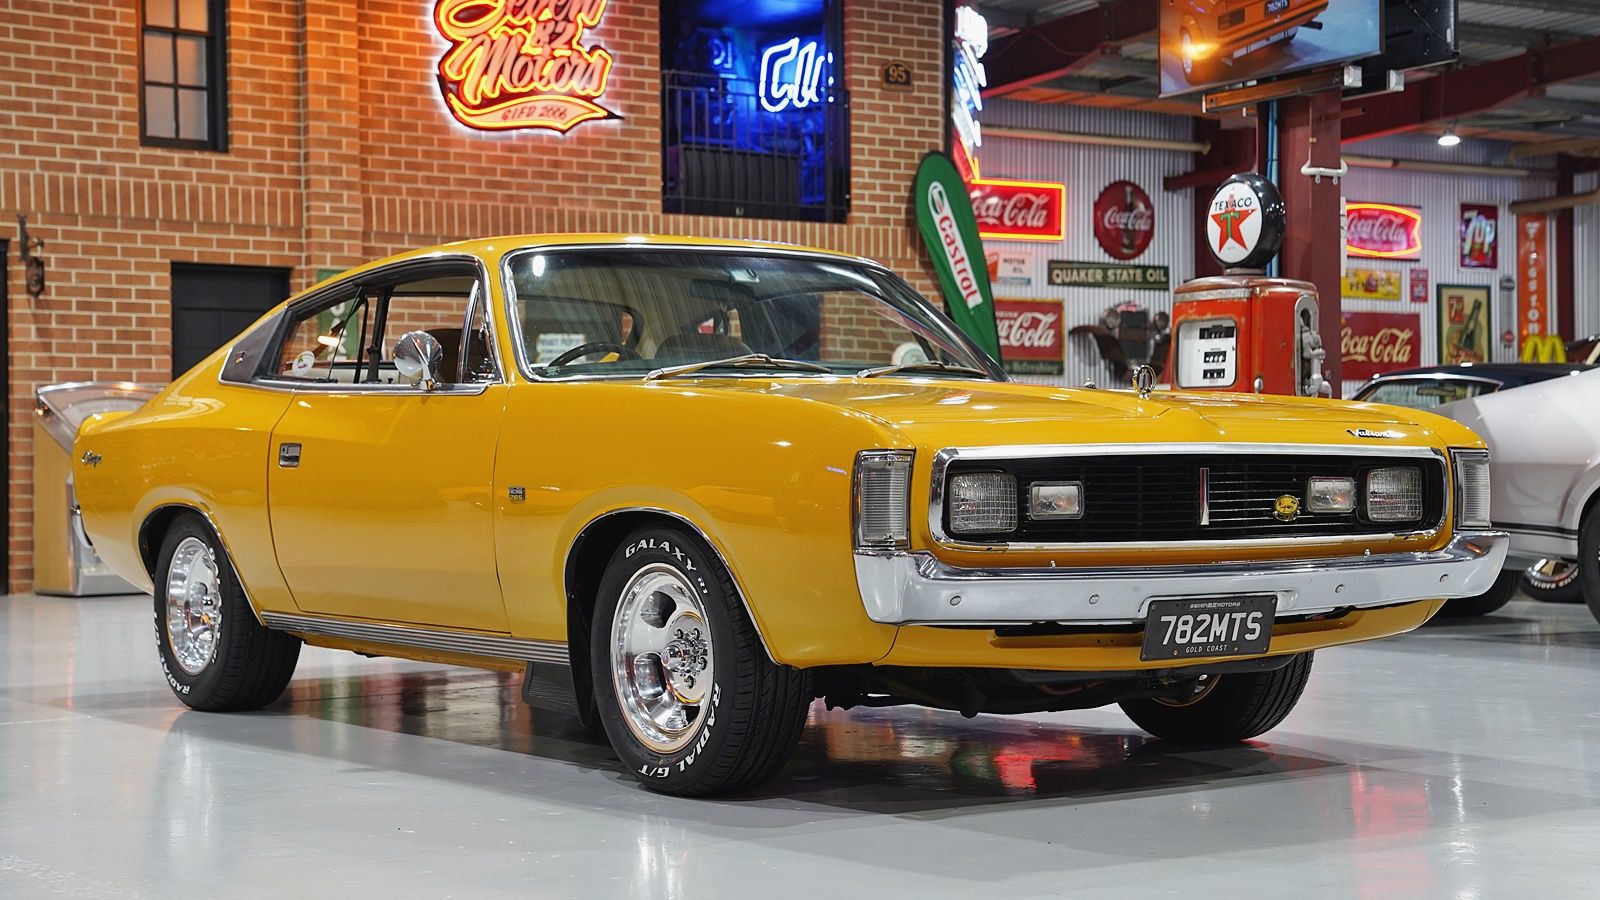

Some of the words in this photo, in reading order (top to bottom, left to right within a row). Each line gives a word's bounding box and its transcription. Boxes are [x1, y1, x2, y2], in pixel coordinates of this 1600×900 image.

[446, 35, 607, 104] Motors
[889, 65, 906, 83] 95
[1214, 197, 1252, 211] TEXACO
[940, 216, 977, 300] Castrol
[1052, 269, 1104, 284] QUAKER
[1107, 269, 1143, 282] STATE
[1146, 269, 1167, 282] OIL
[624, 538, 697, 572] GALAXY
[1160, 611, 1263, 645] 782MTS
[1185, 645, 1203, 654] GOLD
[1206, 644, 1228, 653] COAST
[679, 682, 723, 773] RADIAL
[638, 764, 670, 778] G/T
